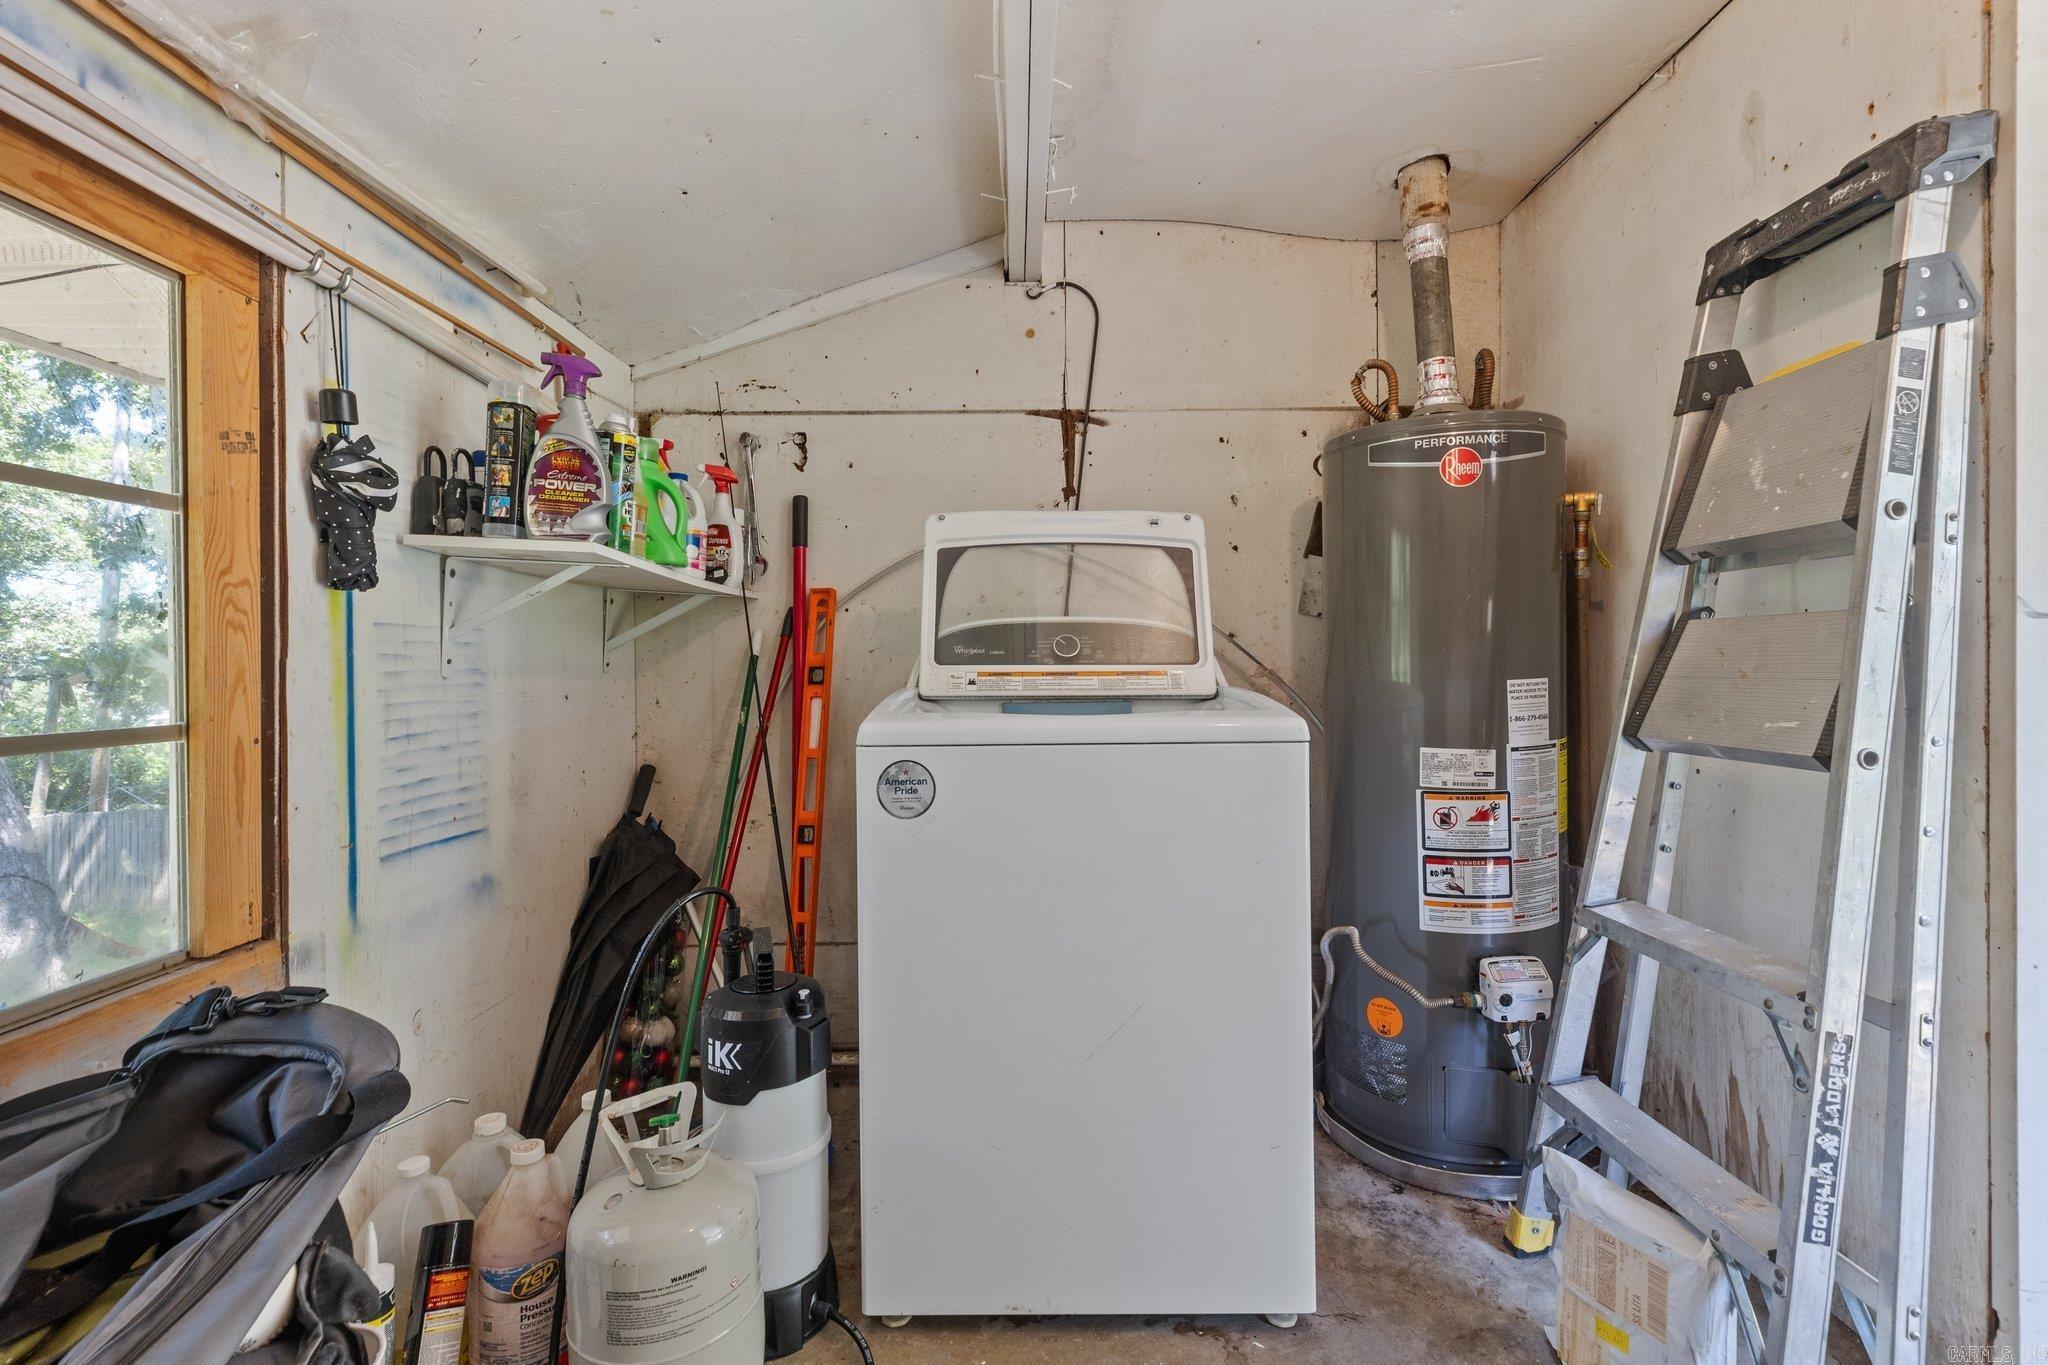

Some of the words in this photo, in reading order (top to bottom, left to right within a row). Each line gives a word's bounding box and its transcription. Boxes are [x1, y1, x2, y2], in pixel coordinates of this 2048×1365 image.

[1414, 434, 1508, 450] PERFORMANCE
[551, 452, 580, 462] PURPLE
[551, 460, 580, 471] POWER
[1446, 449, 1480, 481] Rheem
[547, 469, 588, 481] Extreme
[533, 478, 597, 493] POWER
[538, 493, 590, 503] DEGREASER
[544, 489, 585, 498] CLEANER
[954, 647, 985, 656] Whirlpool
[884, 777, 928, 786] American
[894, 786, 919, 795] Pride
[1824, 1041, 1847, 1128] LADDERS
[1810, 1161, 1834, 1243] GORILLA
[670, 1265, 708, 1284] WARNING!
[520, 1296, 554, 1314] House
[1631, 1294, 1642, 1315] LITA
[520, 1305, 555, 1323] Pressu
[1631, 1316, 1642, 1327] SS
